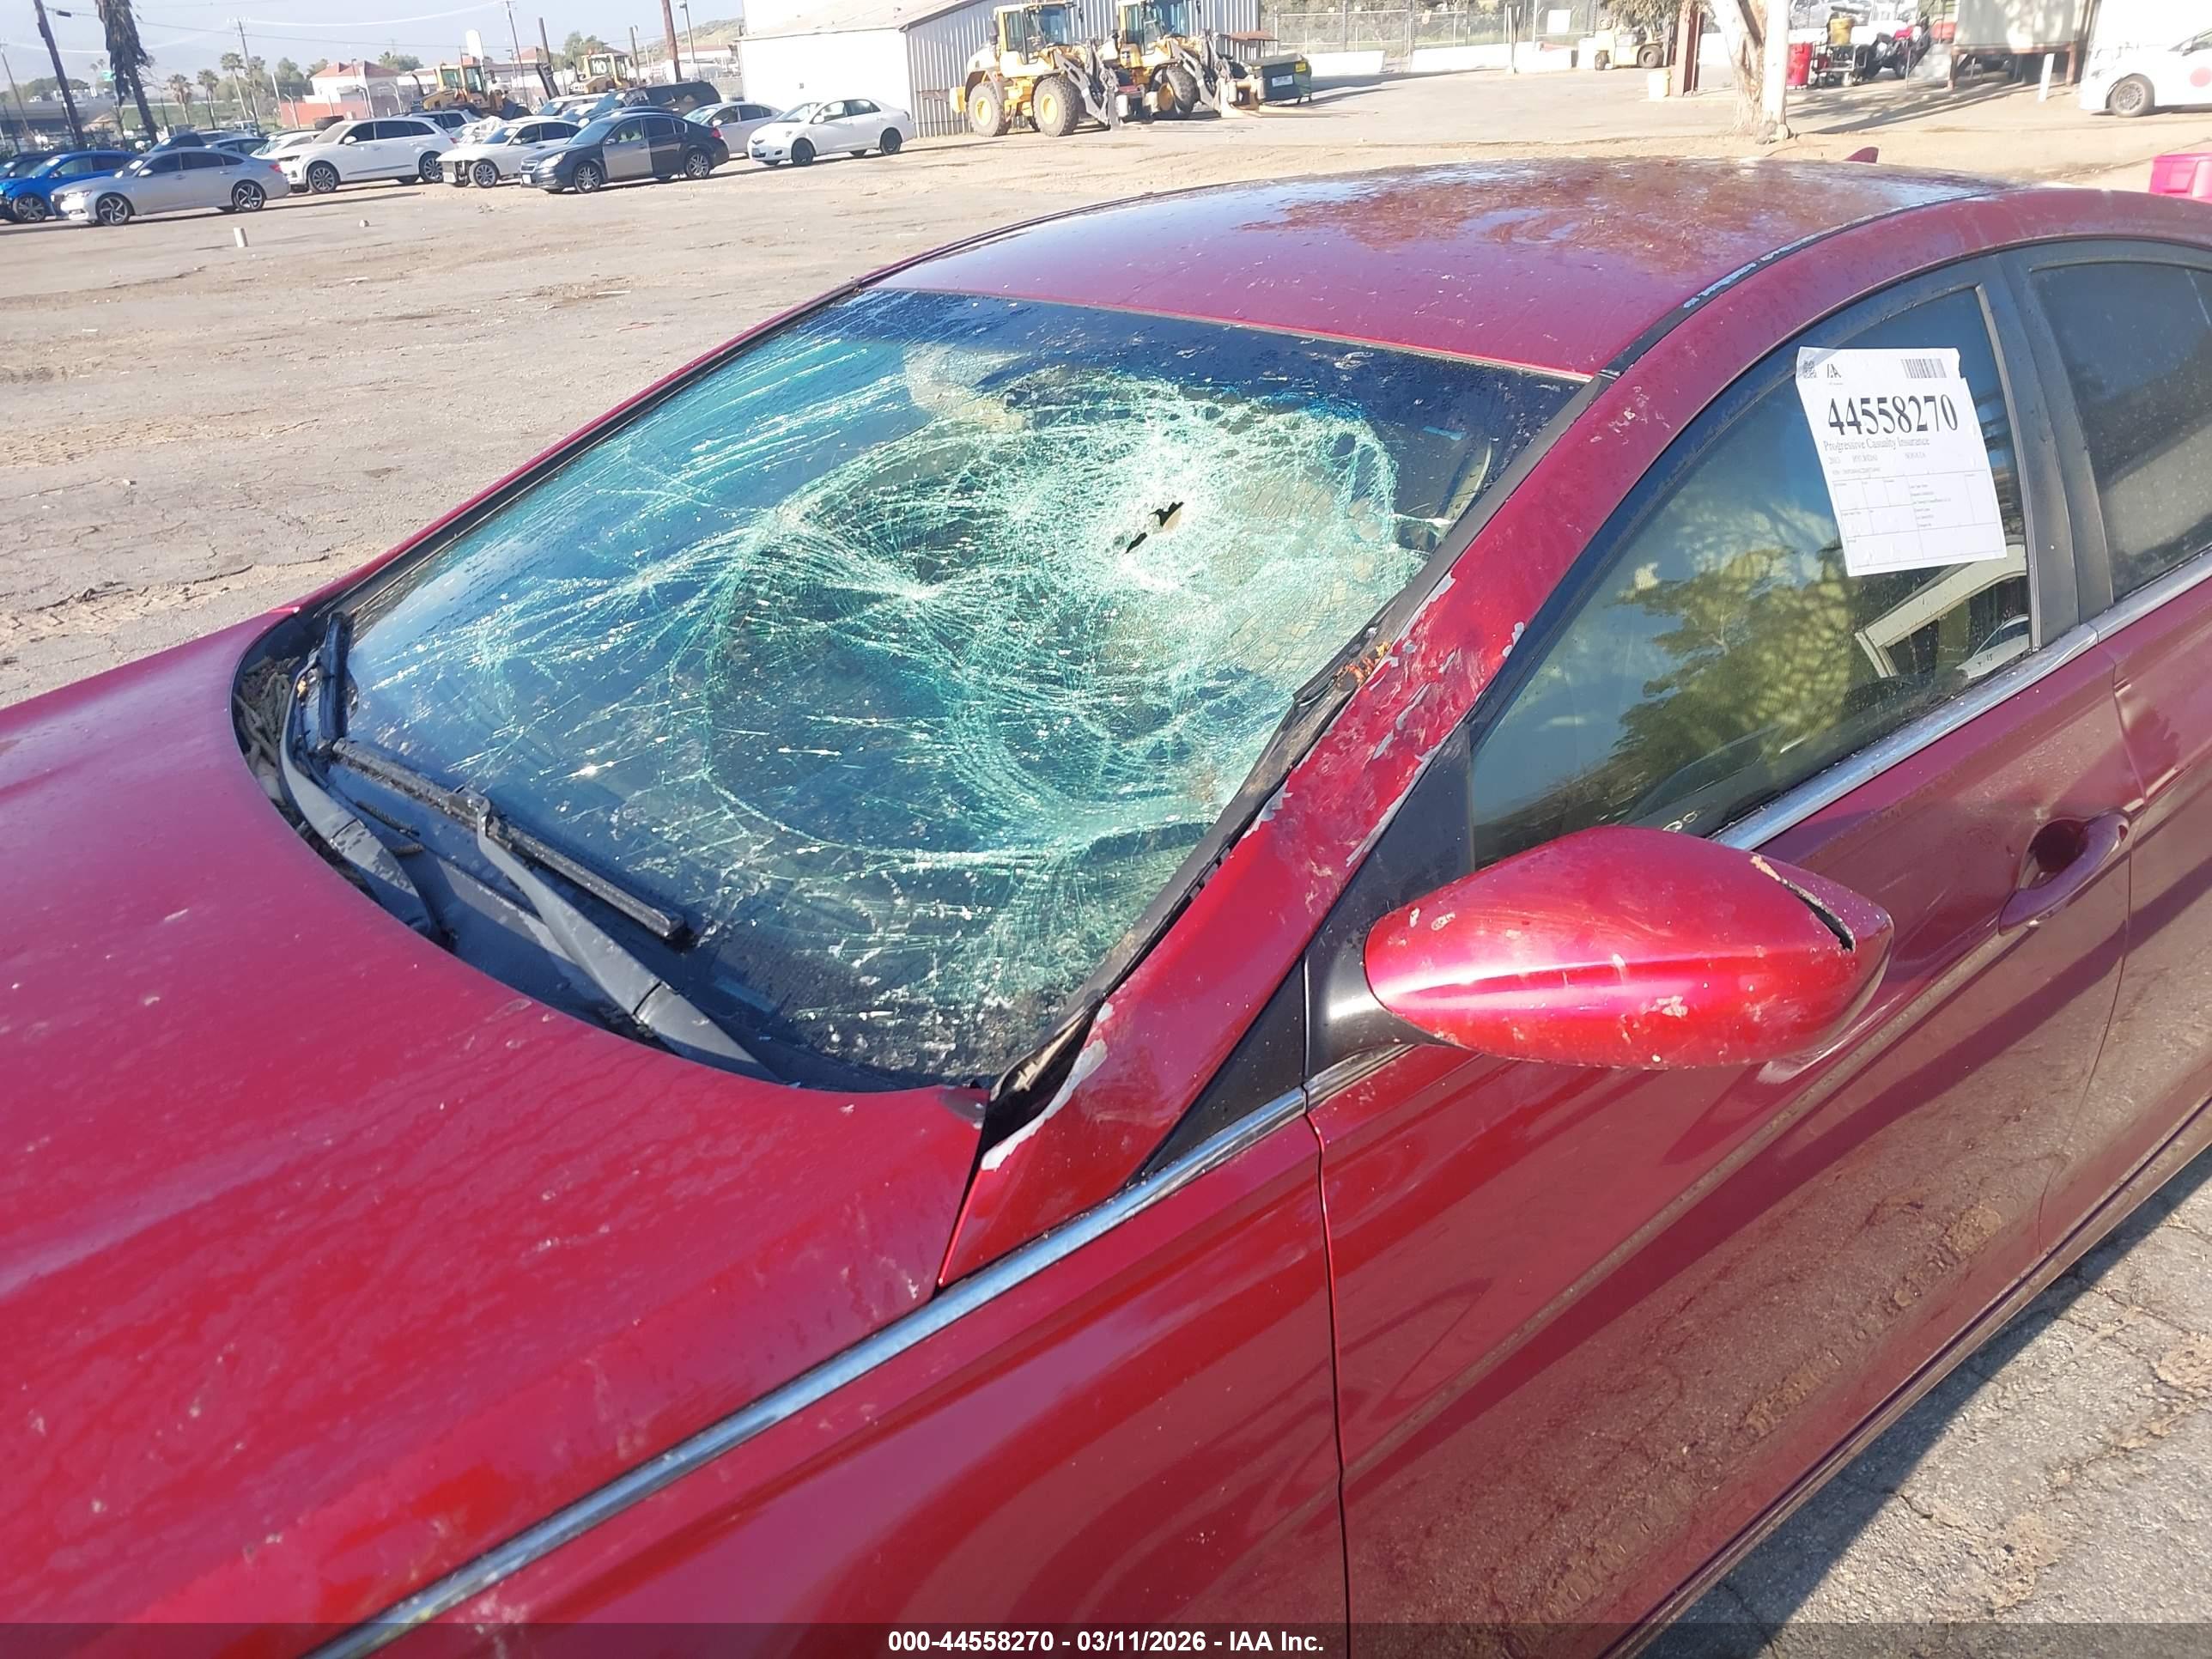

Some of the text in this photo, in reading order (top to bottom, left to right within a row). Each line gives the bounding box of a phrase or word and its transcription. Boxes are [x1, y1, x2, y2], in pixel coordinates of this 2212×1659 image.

[1828, 394, 1958, 435] 44558270
[1823, 436, 1930, 453] Progressive Casualty Insurance
